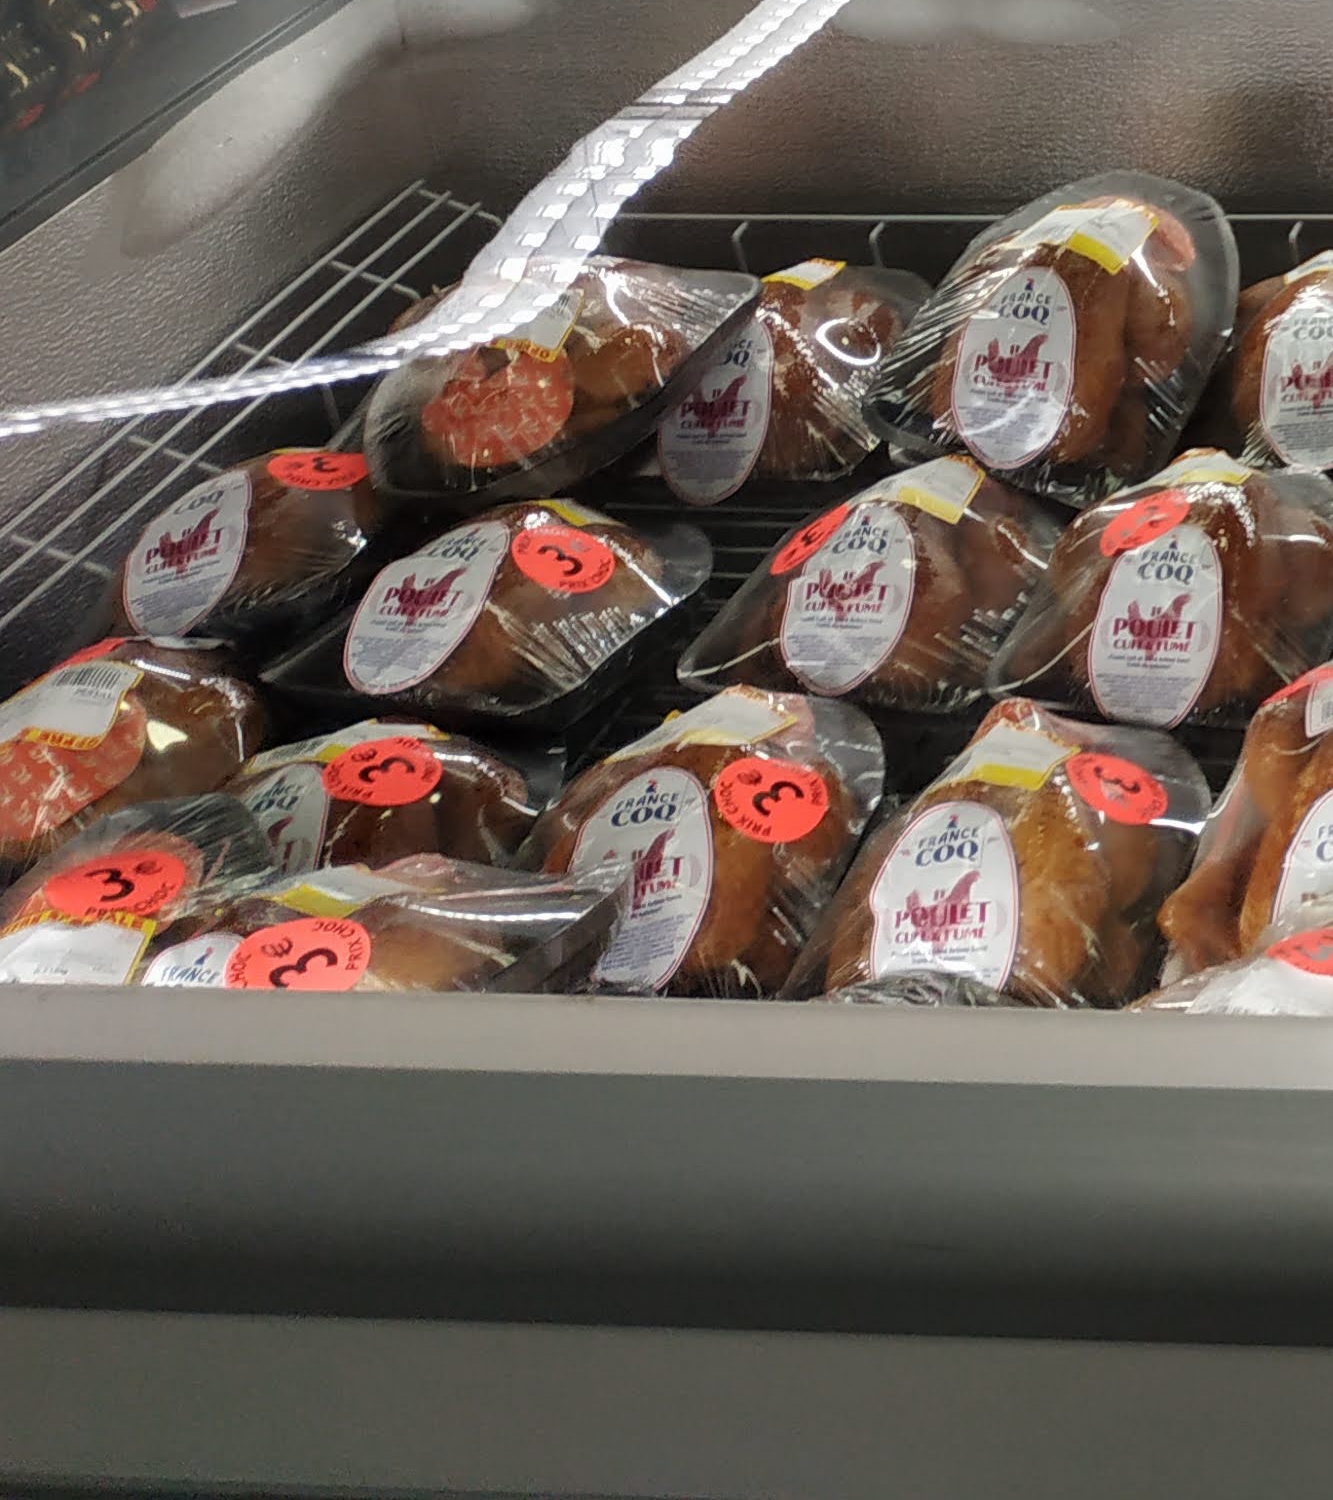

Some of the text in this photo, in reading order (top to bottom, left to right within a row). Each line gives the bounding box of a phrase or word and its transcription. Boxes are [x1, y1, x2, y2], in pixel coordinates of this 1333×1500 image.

[1001, 291, 1053, 305] FRANCE
[1000, 304, 1051, 326] COQ
[832, 537, 888, 555] COQ
[1141, 550, 1199, 564] FRANCE
[1137, 563, 1195, 584] COQ
[1112, 617, 1195, 641] POULET
[615, 793, 679, 810] FRANCE
[611, 804, 678, 827] COQ
[738, 817, 773, 838] PRIX
[918, 826, 979, 850] FRANCE
[915, 839, 979, 868] COQ
[134, 880, 176, 916] CHOC
[894, 901, 991, 928] POULET
